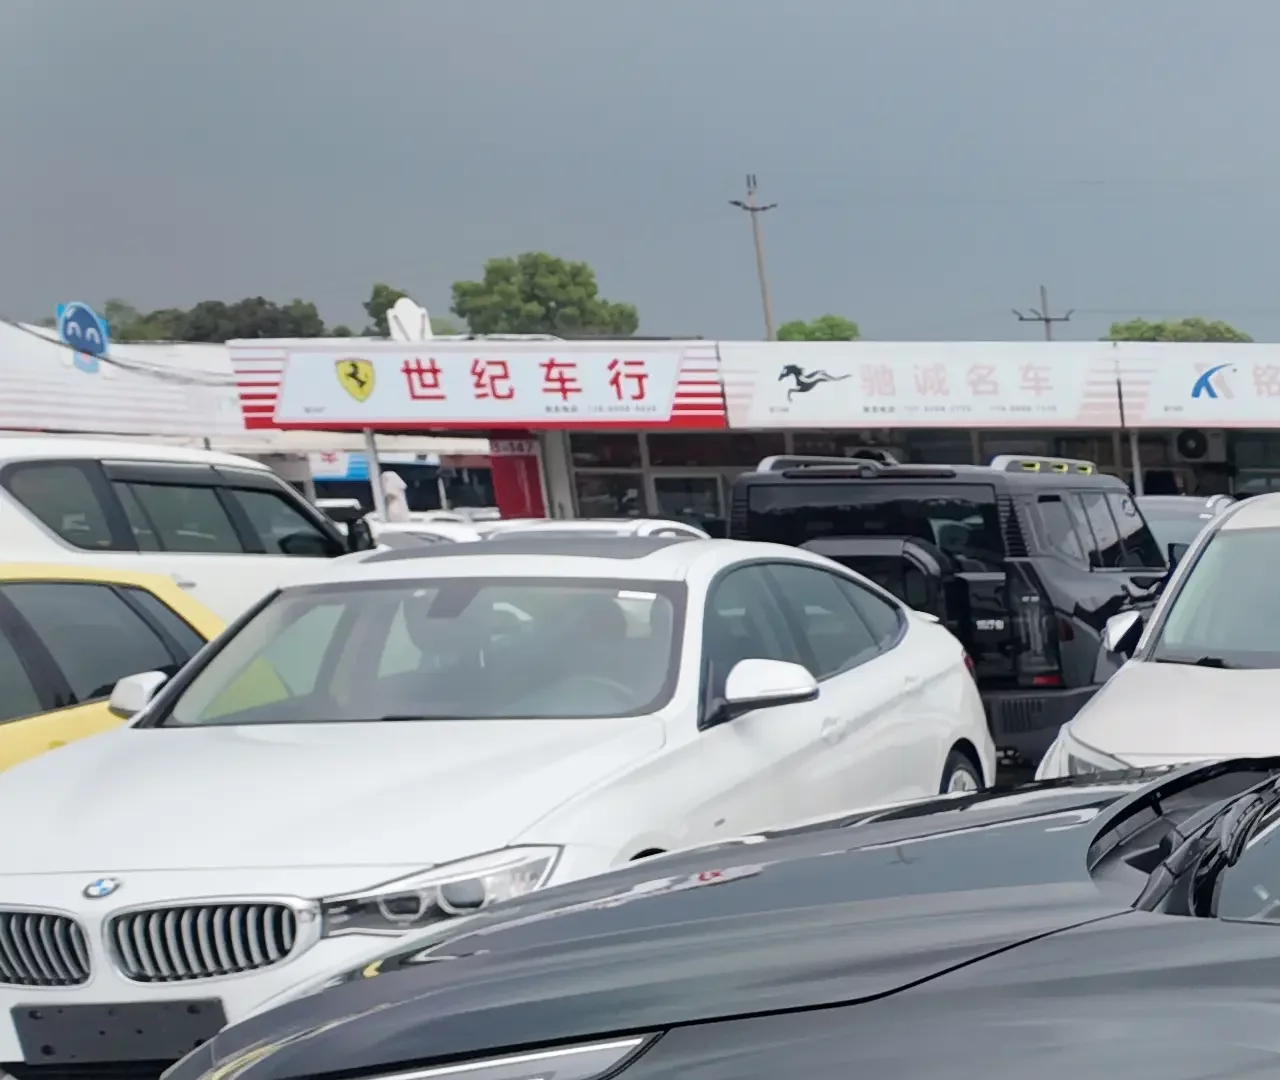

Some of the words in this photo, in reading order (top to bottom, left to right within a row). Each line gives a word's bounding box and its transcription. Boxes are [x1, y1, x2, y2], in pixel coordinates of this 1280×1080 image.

[401, 358, 649, 401] 世纪车行
[860, 362, 1054, 398] 驰诚名车
